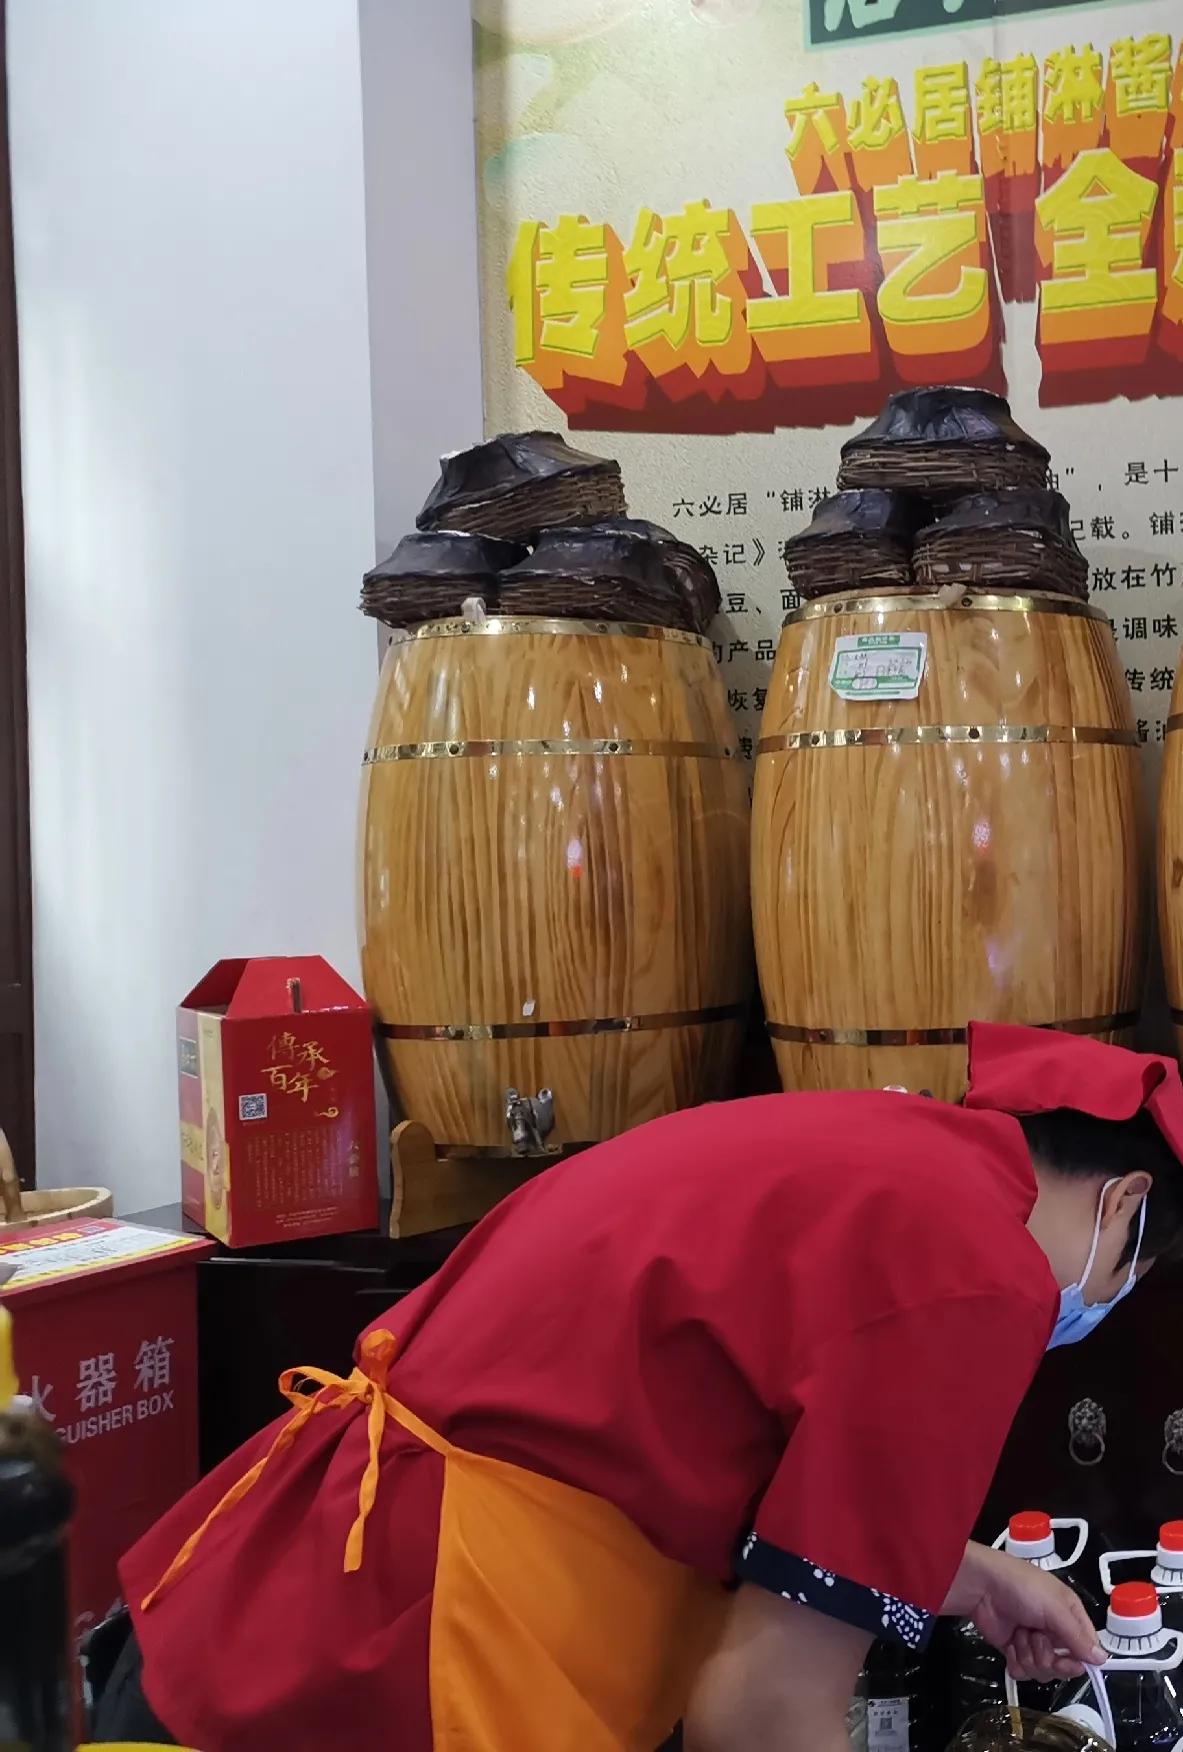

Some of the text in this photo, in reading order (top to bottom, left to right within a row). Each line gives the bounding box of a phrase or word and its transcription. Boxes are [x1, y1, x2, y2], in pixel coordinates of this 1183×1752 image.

[507, 170, 990, 367] 传统工艺
[699, 538, 786, 566] 杂记》
[137, 1389, 175, 1420] BOX
